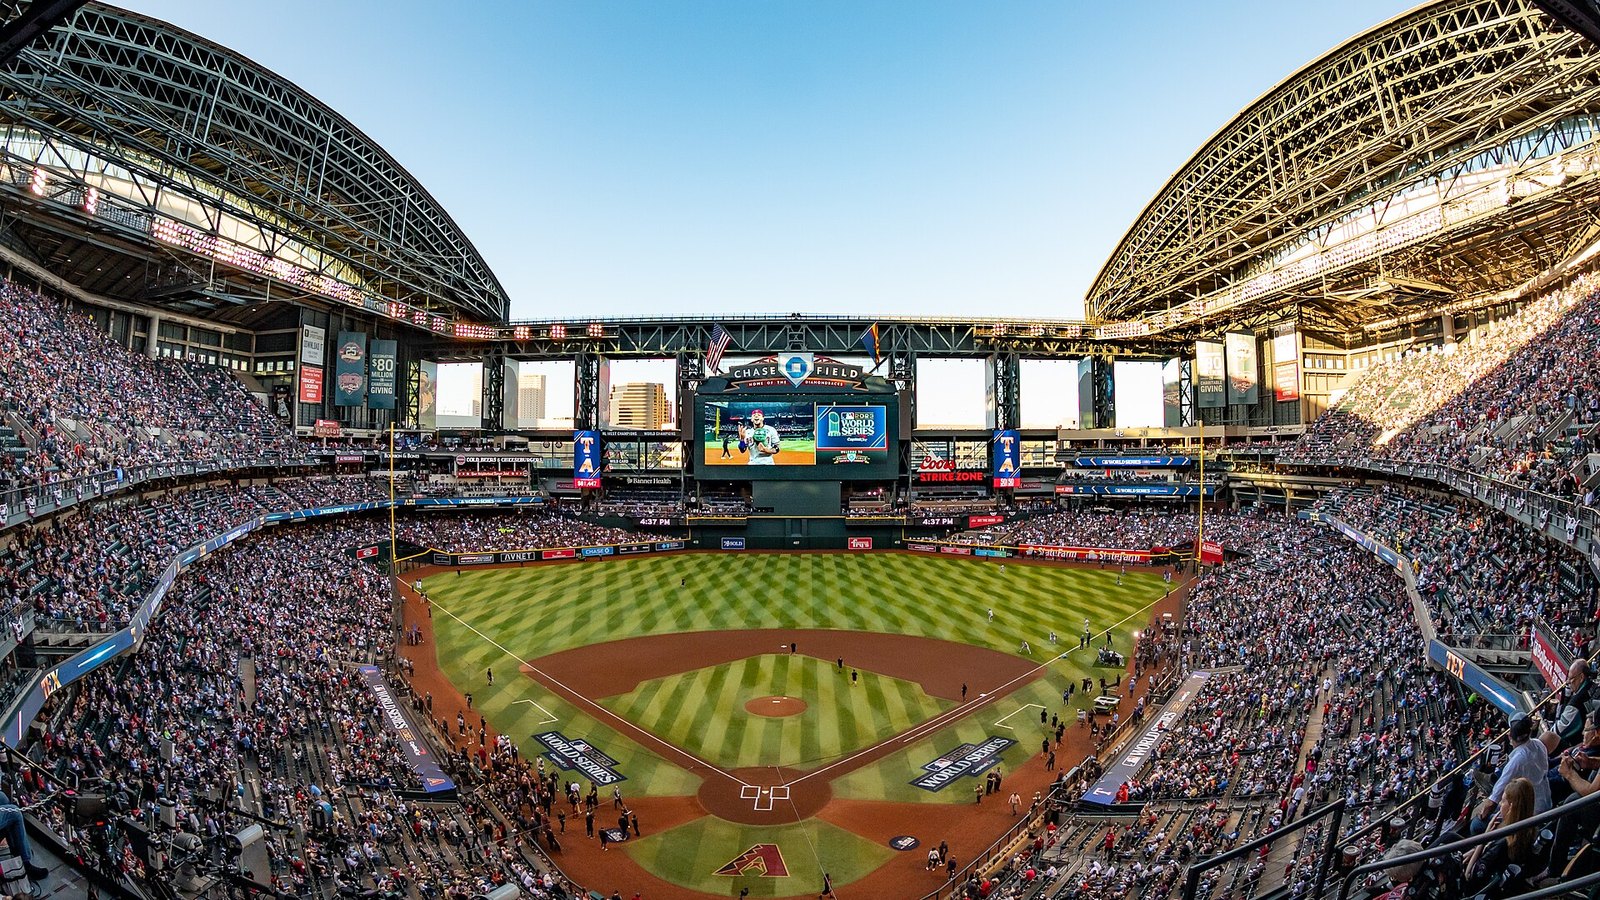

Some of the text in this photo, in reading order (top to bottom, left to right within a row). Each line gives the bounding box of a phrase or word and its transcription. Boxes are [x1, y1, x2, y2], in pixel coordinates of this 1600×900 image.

[372, 358, 394, 371] $80
[733, 365, 776, 379] CHASE
[816, 366, 859, 379] FIELD
[1200, 385, 1223, 393] GIVING
[841, 427, 875, 435] SERIES
[580, 437, 594, 453] T
[1000, 436, 1014, 453] T
[578, 458, 594, 473] A
[919, 455, 956, 470] Coors
[998, 457, 1014, 473] A
[633, 477, 672, 485] Banner Health
[919, 471, 983, 482] STRIKE ZONE
[1445, 650, 1466, 681] TEX
[40, 669, 62, 699] TEX
[376, 691, 408, 729] WORLD SERIES
[1129, 731, 1160, 756] WORLD
[541, 733, 617, 783] WORLD SERIES
[918, 738, 1009, 788] WORLD SERIES
